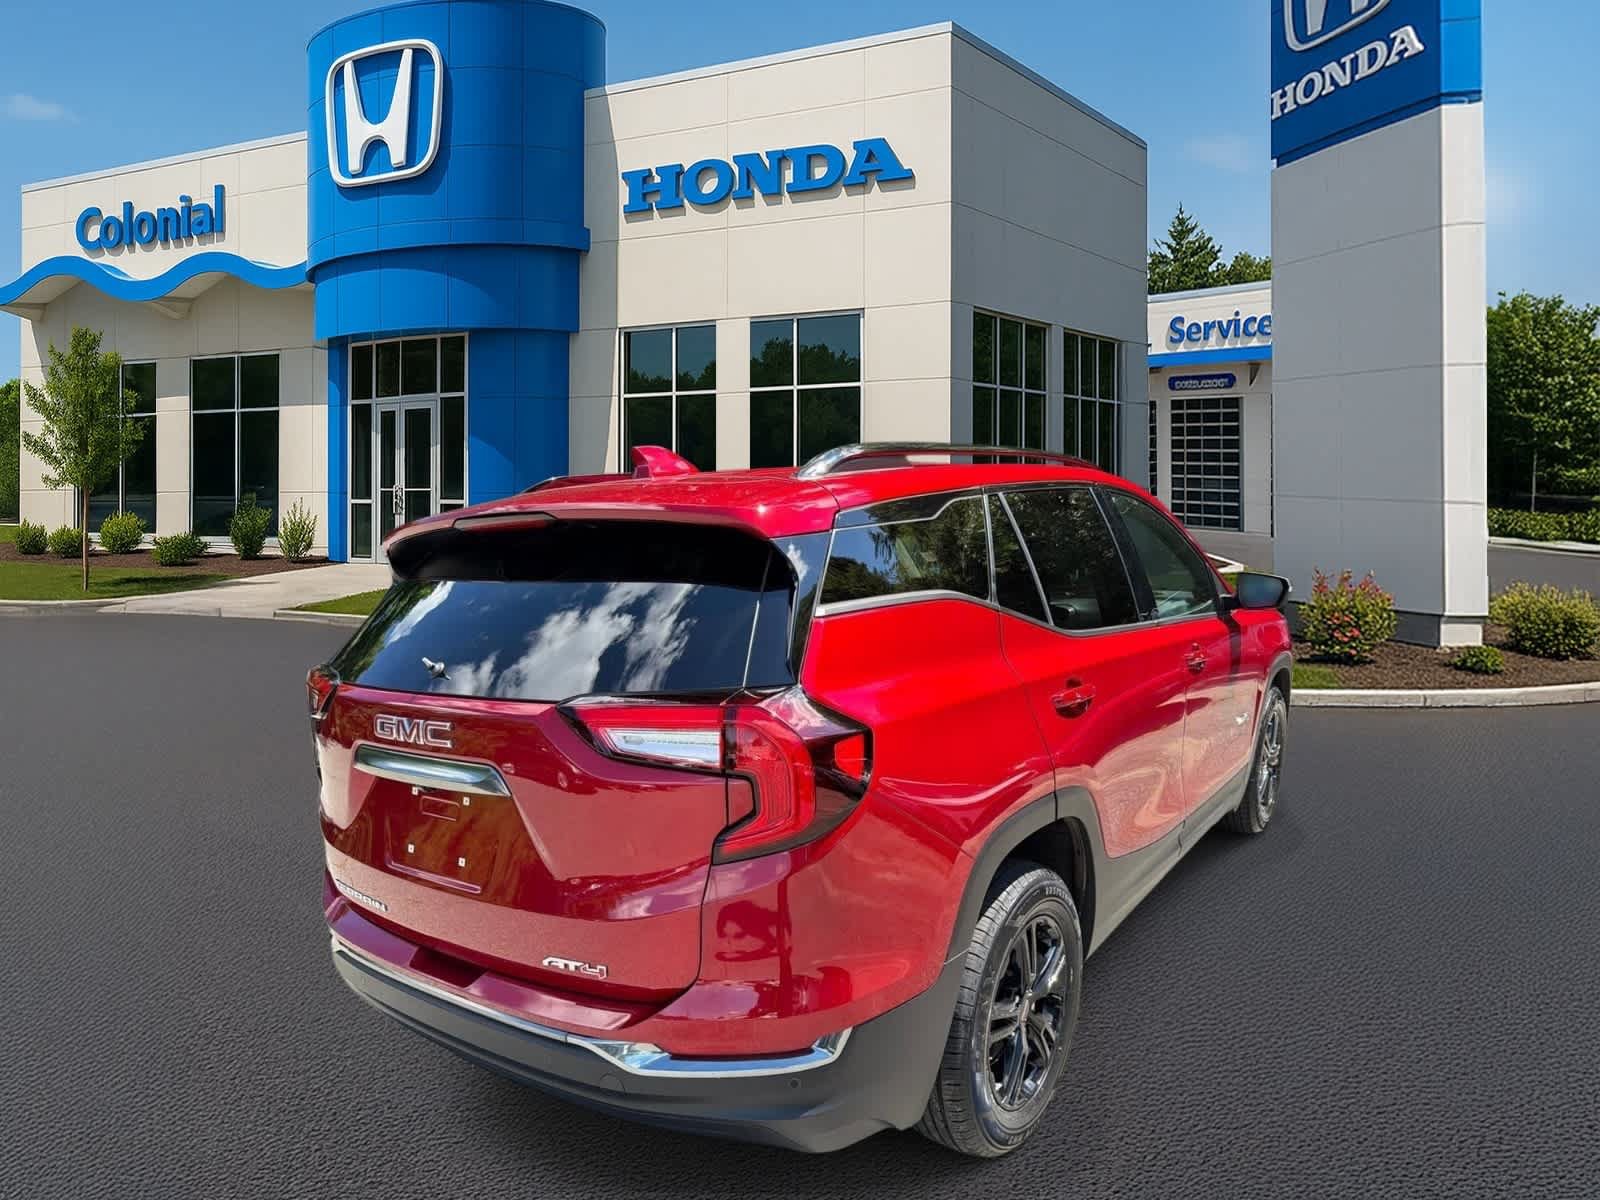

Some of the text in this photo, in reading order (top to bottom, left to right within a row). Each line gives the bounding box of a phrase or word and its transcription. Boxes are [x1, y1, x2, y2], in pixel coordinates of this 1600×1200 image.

[1271, 25, 1424, 120] HONDA
[622, 137, 913, 214] HONDA
[75, 184, 225, 251] Colonial
[1169, 310, 1272, 344] Service
[374, 714, 453, 748] GMC
[542, 956, 608, 980] AT4
